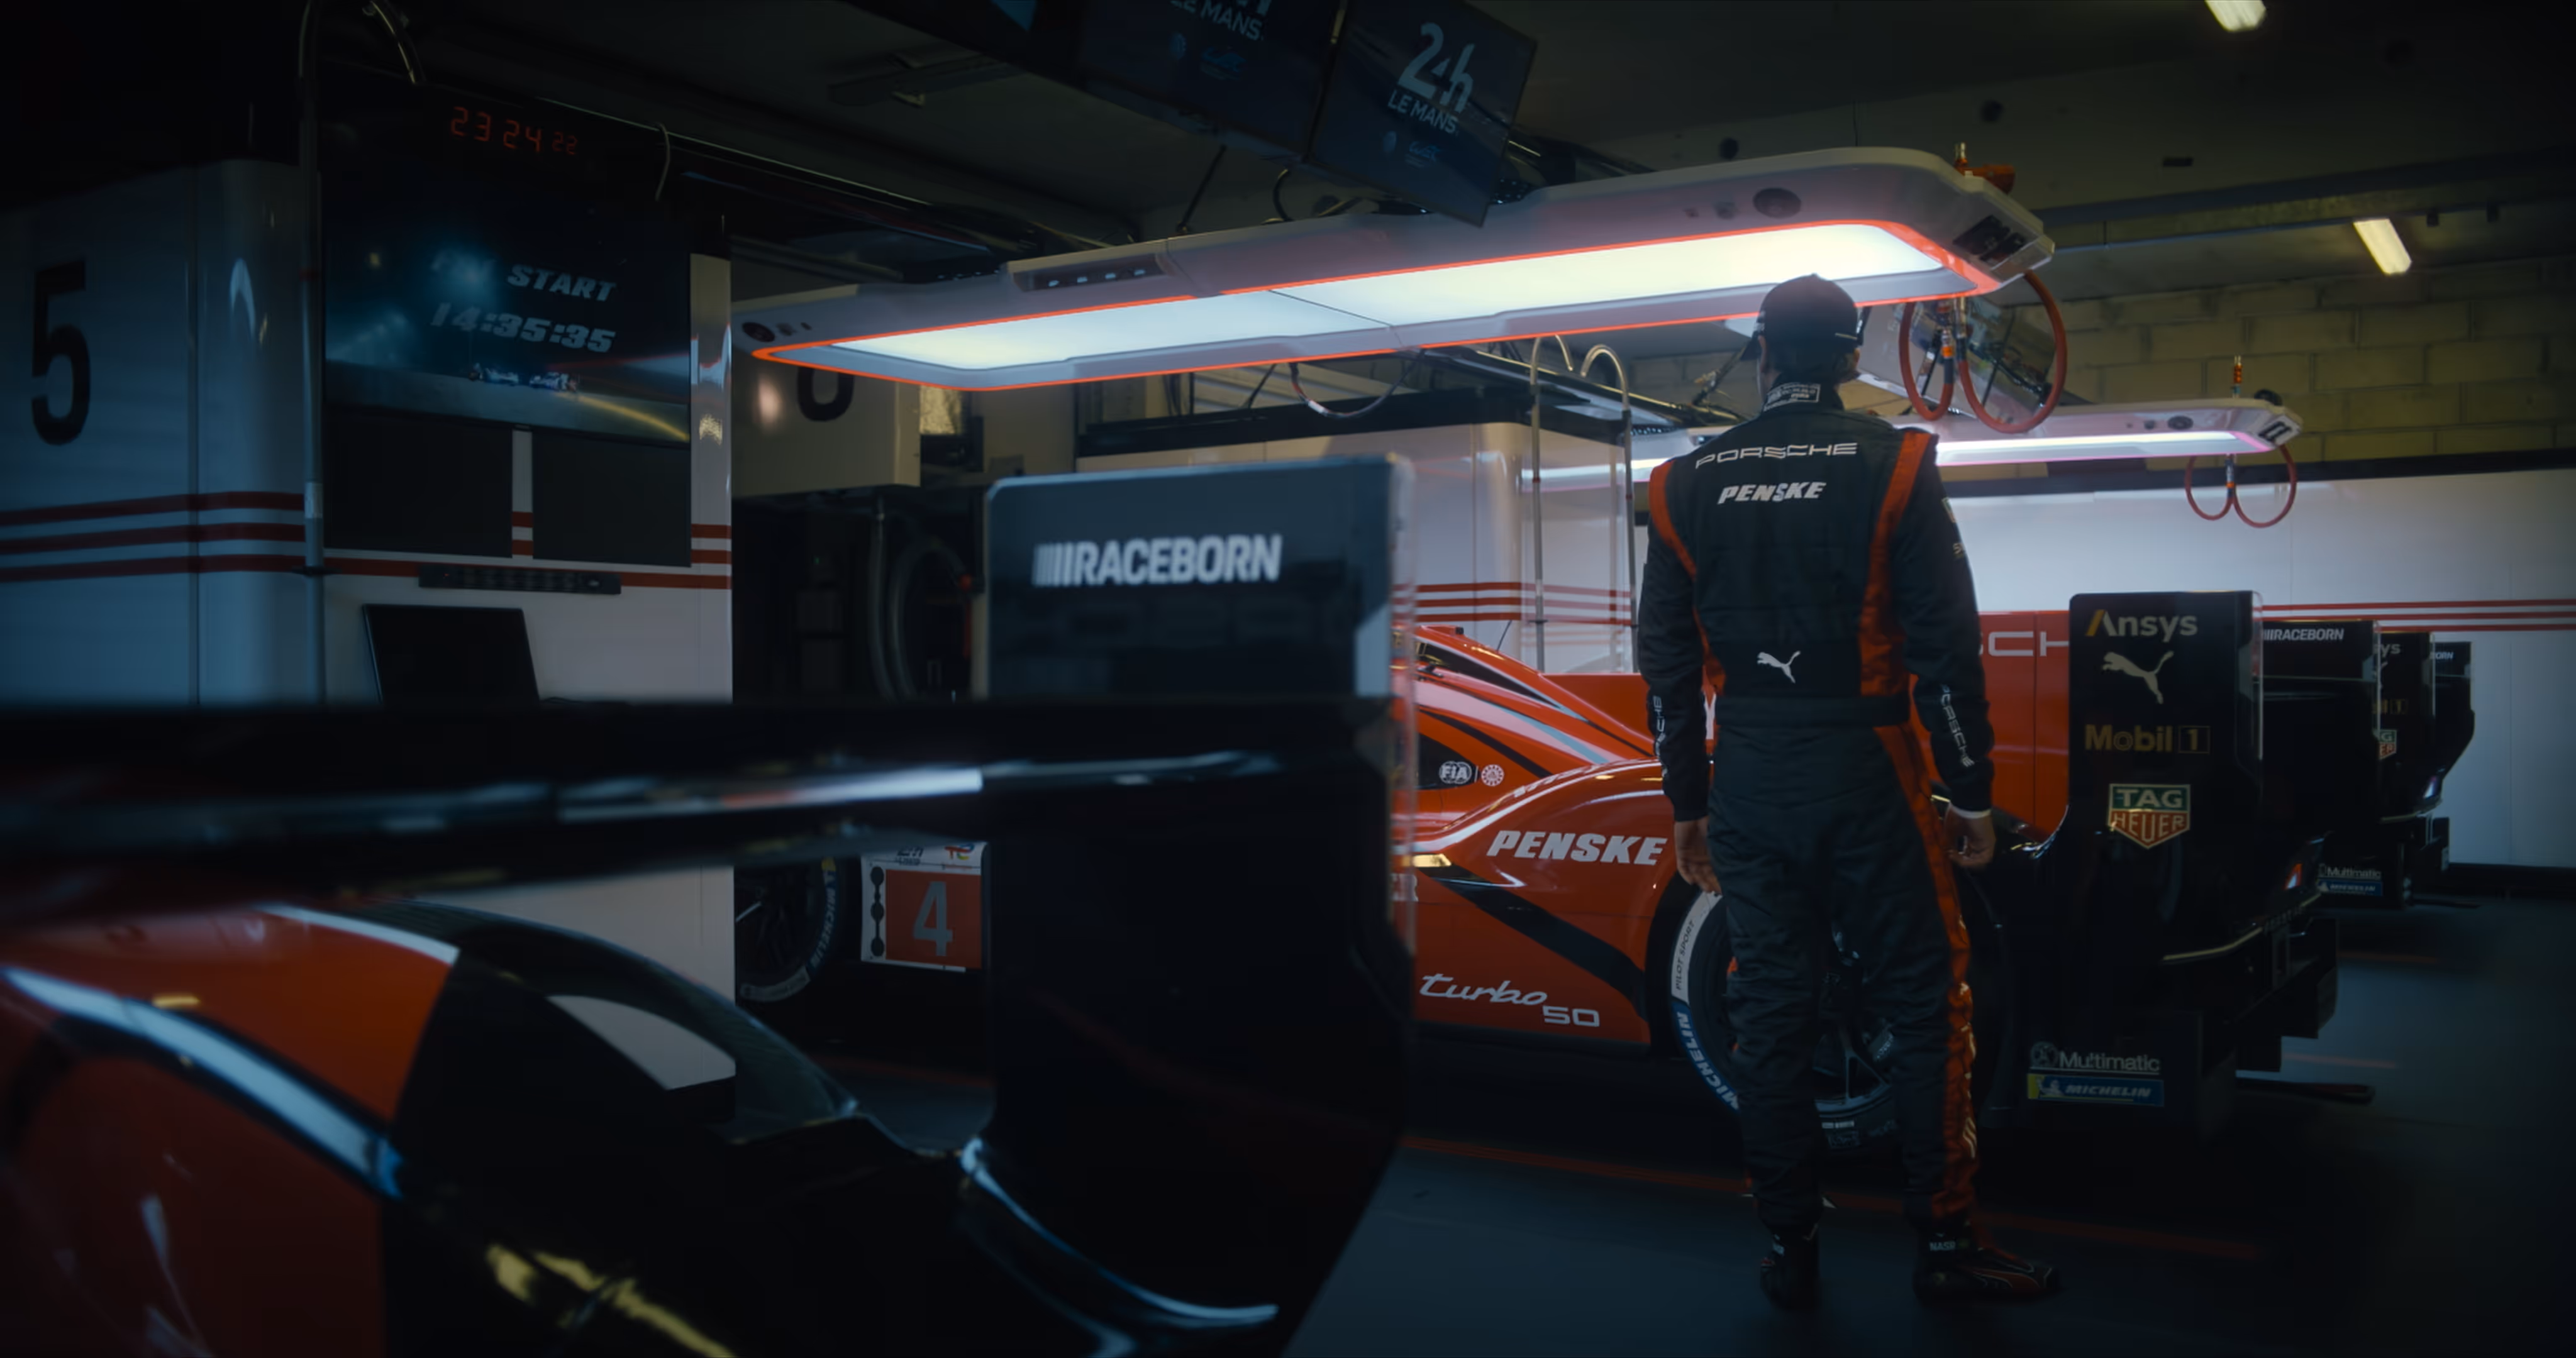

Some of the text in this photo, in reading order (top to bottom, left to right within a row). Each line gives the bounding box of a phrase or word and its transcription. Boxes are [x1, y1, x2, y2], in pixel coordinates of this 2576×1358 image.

[1387, 89, 1459, 134] LE MANS
[450, 106, 492, 142] 23
[503, 118, 543, 152] 24
[508, 263, 616, 302] START
[31, 261, 90, 445] 5
[1695, 442, 1858, 470] PORSCHE
[1717, 481, 1827, 505] PENSKE
[1071, 534, 1282, 587] RACEBORN
[2085, 609, 2199, 643] Ansys
[2275, 628, 2345, 641] RACEBORN
[2085, 724, 2174, 752] Mobil
[2116, 788, 2184, 808] TAG
[2113, 812, 2185, 843] HEUER
[1486, 830, 1668, 865] PENSKE
[913, 881, 953, 957] 4
[1419, 973, 1548, 1005] turbo
[1542, 1005, 1600, 1027] 50
[1677, 1011, 1740, 1110] MICHELIN
[2059, 1051, 2160, 1072] Multimatic
[2065, 1084, 2152, 1098] MICHELIN
